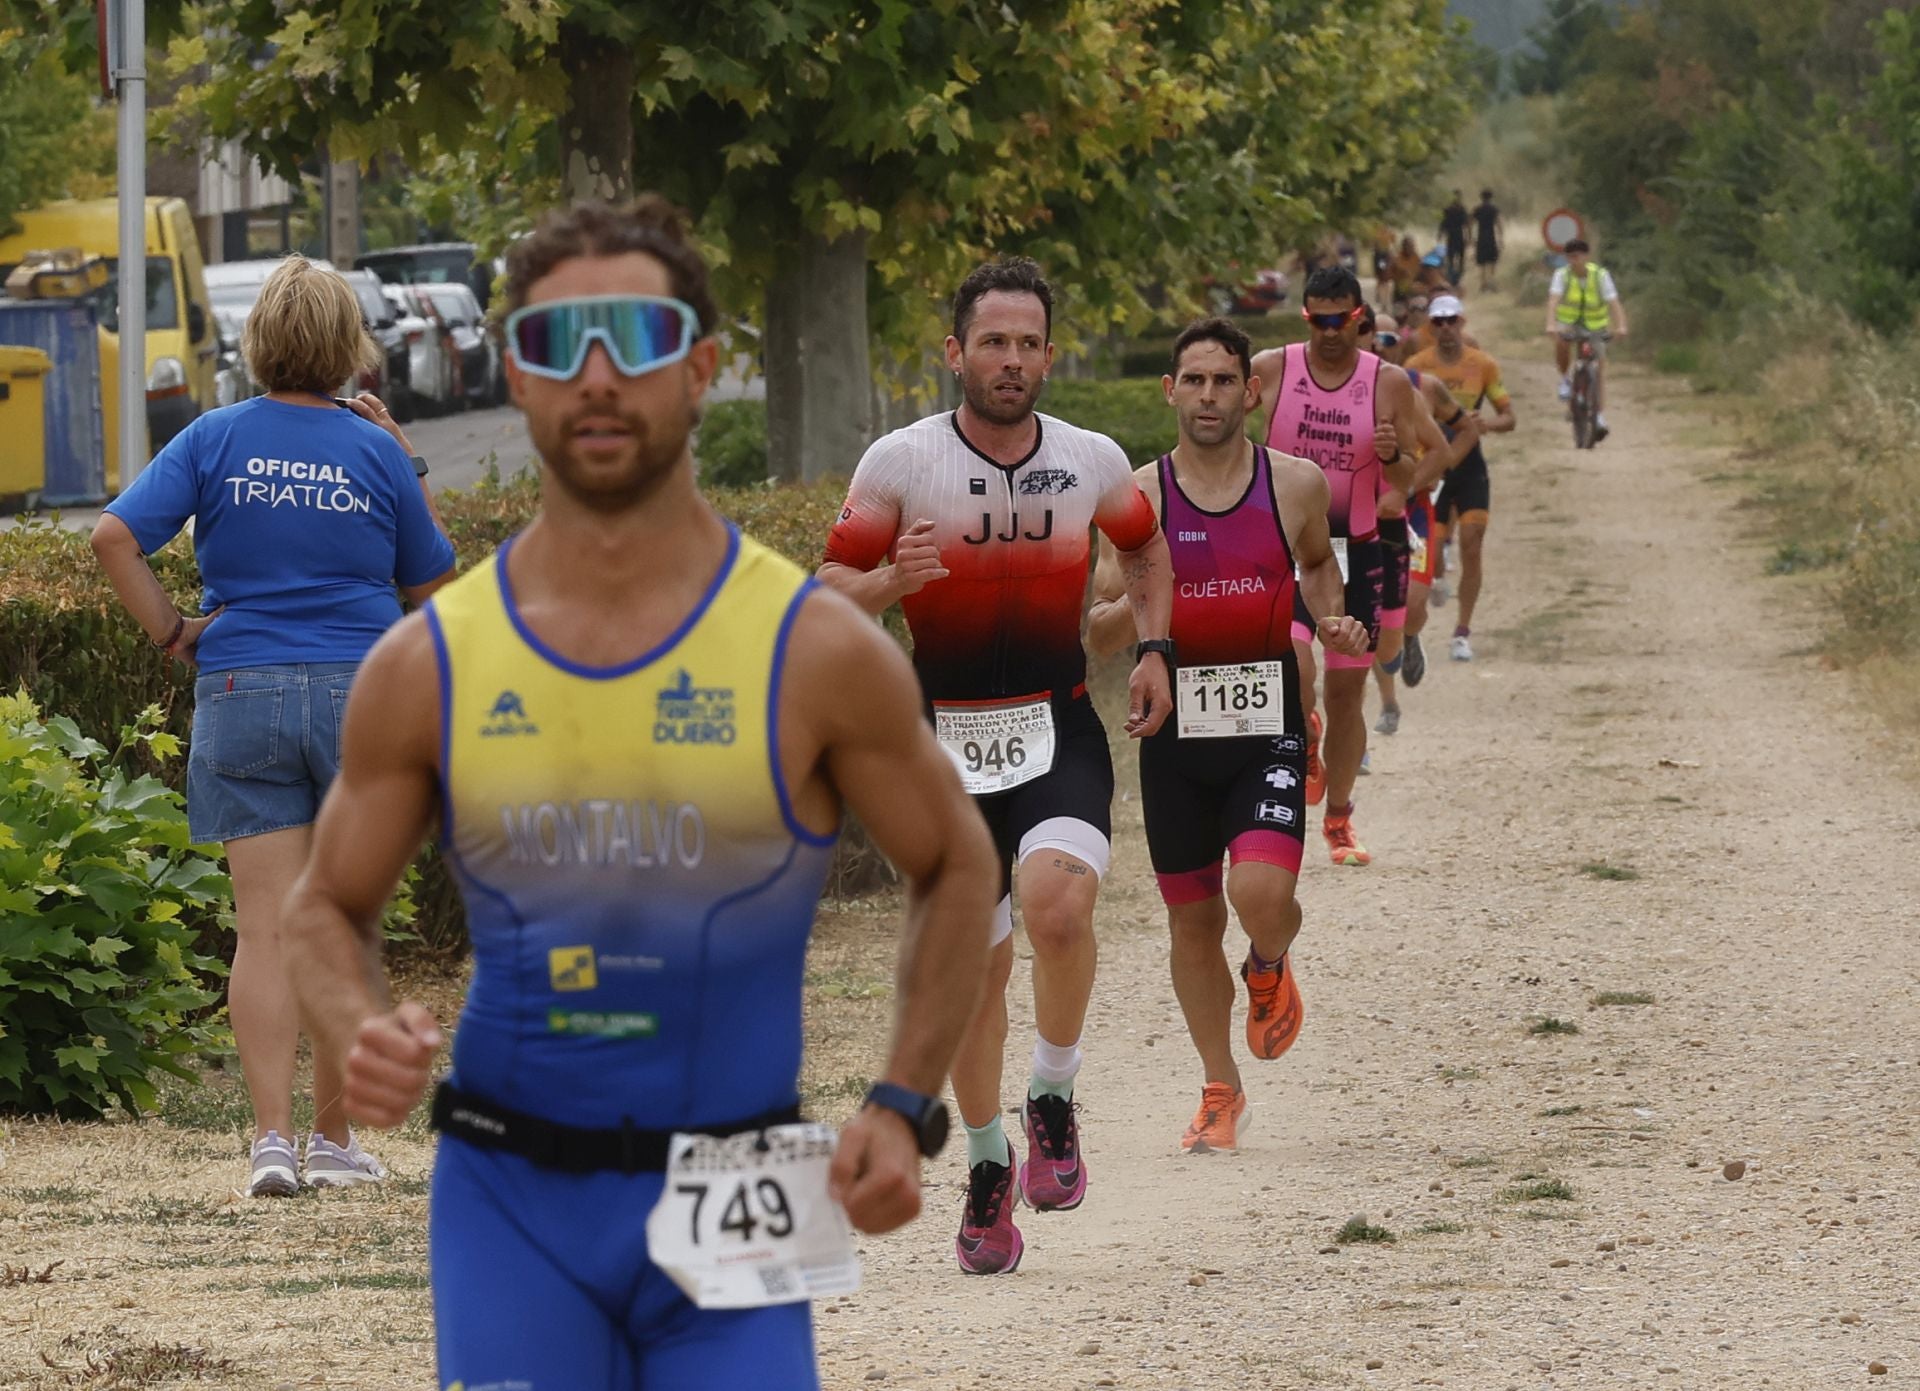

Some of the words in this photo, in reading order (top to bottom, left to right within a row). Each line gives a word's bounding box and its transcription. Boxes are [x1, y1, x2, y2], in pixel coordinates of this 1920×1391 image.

[1303, 403, 1350, 425] Triatlón
[1297, 422, 1352, 448] Pisuerga
[246, 457, 350, 484] OFICIAL
[224, 477, 370, 513] TRIATLÓN
[1178, 531, 1207, 542] GOBIK
[1180, 576, 1266, 598] CUÉTARA
[1194, 681, 1268, 712] 1185
[952, 709, 1024, 722] FEDERACION
[1031, 705, 1046, 714] DE
[953, 719, 1001, 729] TRIATLON
[1032, 712, 1047, 720] DE
[653, 721, 737, 745] DUERO
[954, 727, 1005, 737] CASTILLA
[1019, 719, 1048, 731] LEON
[963, 736, 1026, 773] 946
[501, 799, 704, 869] MONTALVO
[676, 1177, 794, 1244] 749
